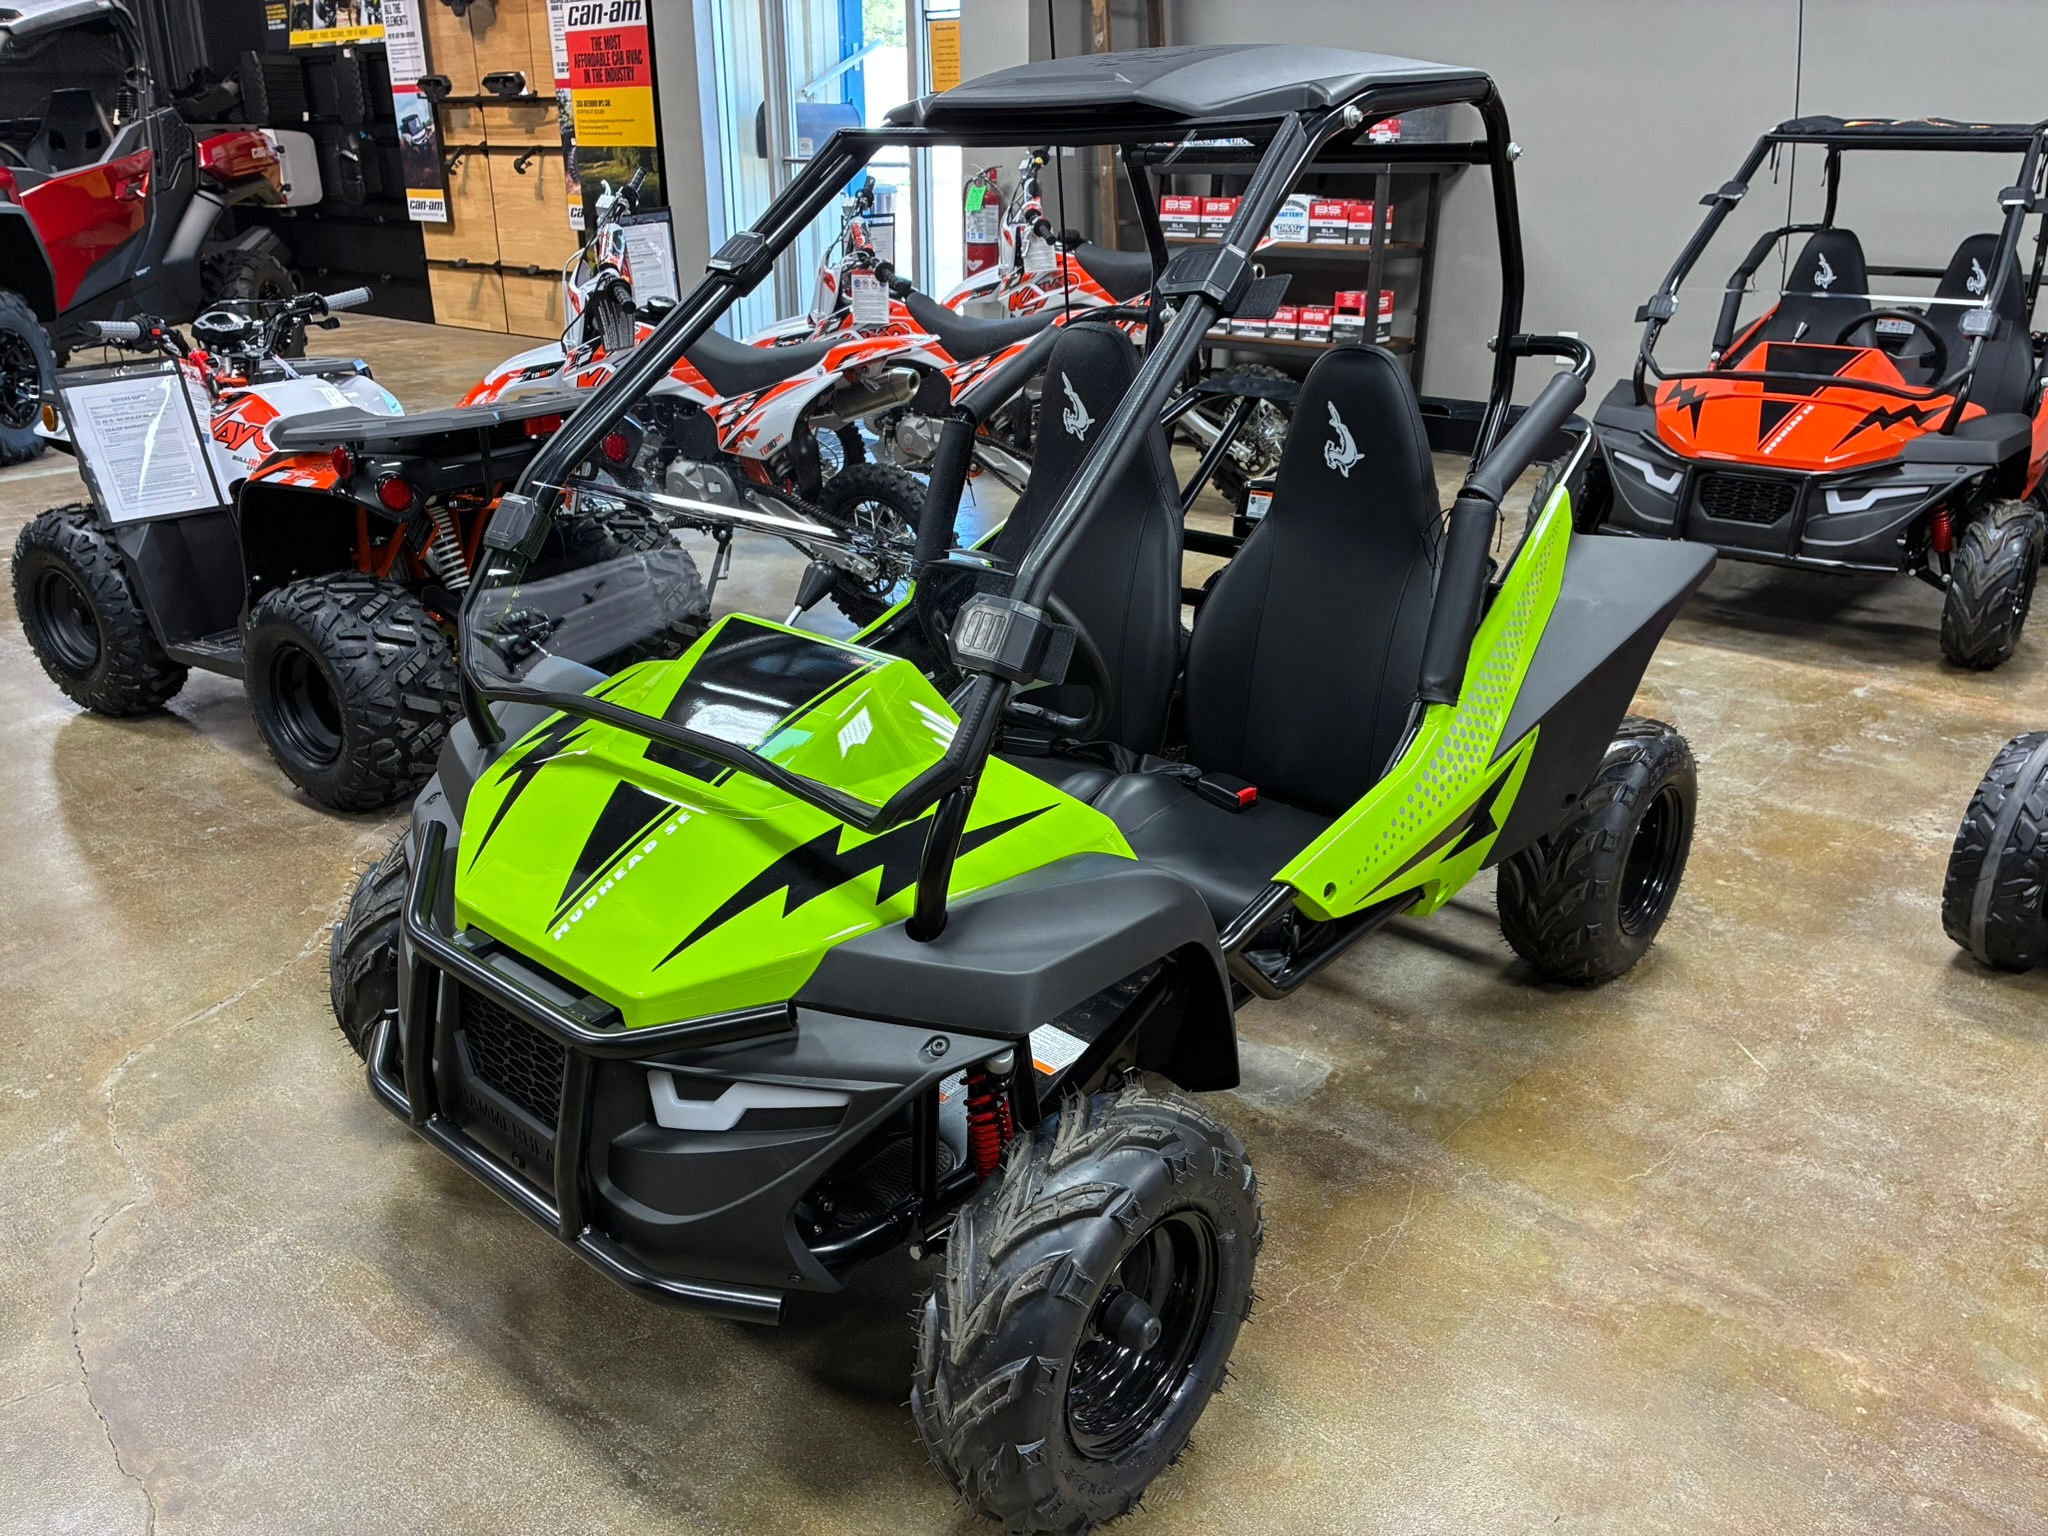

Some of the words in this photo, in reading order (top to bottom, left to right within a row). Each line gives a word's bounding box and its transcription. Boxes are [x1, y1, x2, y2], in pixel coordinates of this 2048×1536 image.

[568, 0, 641, 26] can-am
[590, 36, 602, 51] THE
[603, 34, 621, 50] MOST
[574, 51, 610, 68] AFFORDABLE
[611, 50, 624, 66] CAB
[625, 49, 643, 65] HVAC
[583, 68, 591, 84] IN
[591, 68, 604, 83] THE
[604, 66, 634, 82] INDUSTRY
[409, 199, 443, 212] can-am
[1165, 200, 1192, 209] BS
[1206, 203, 1231, 211] BS
[1315, 205, 1342, 214] BS
[1763, 415, 1803, 455] MUDHEAD
[552, 839, 658, 942] MUDHEAD
[664, 811, 692, 836] SE
